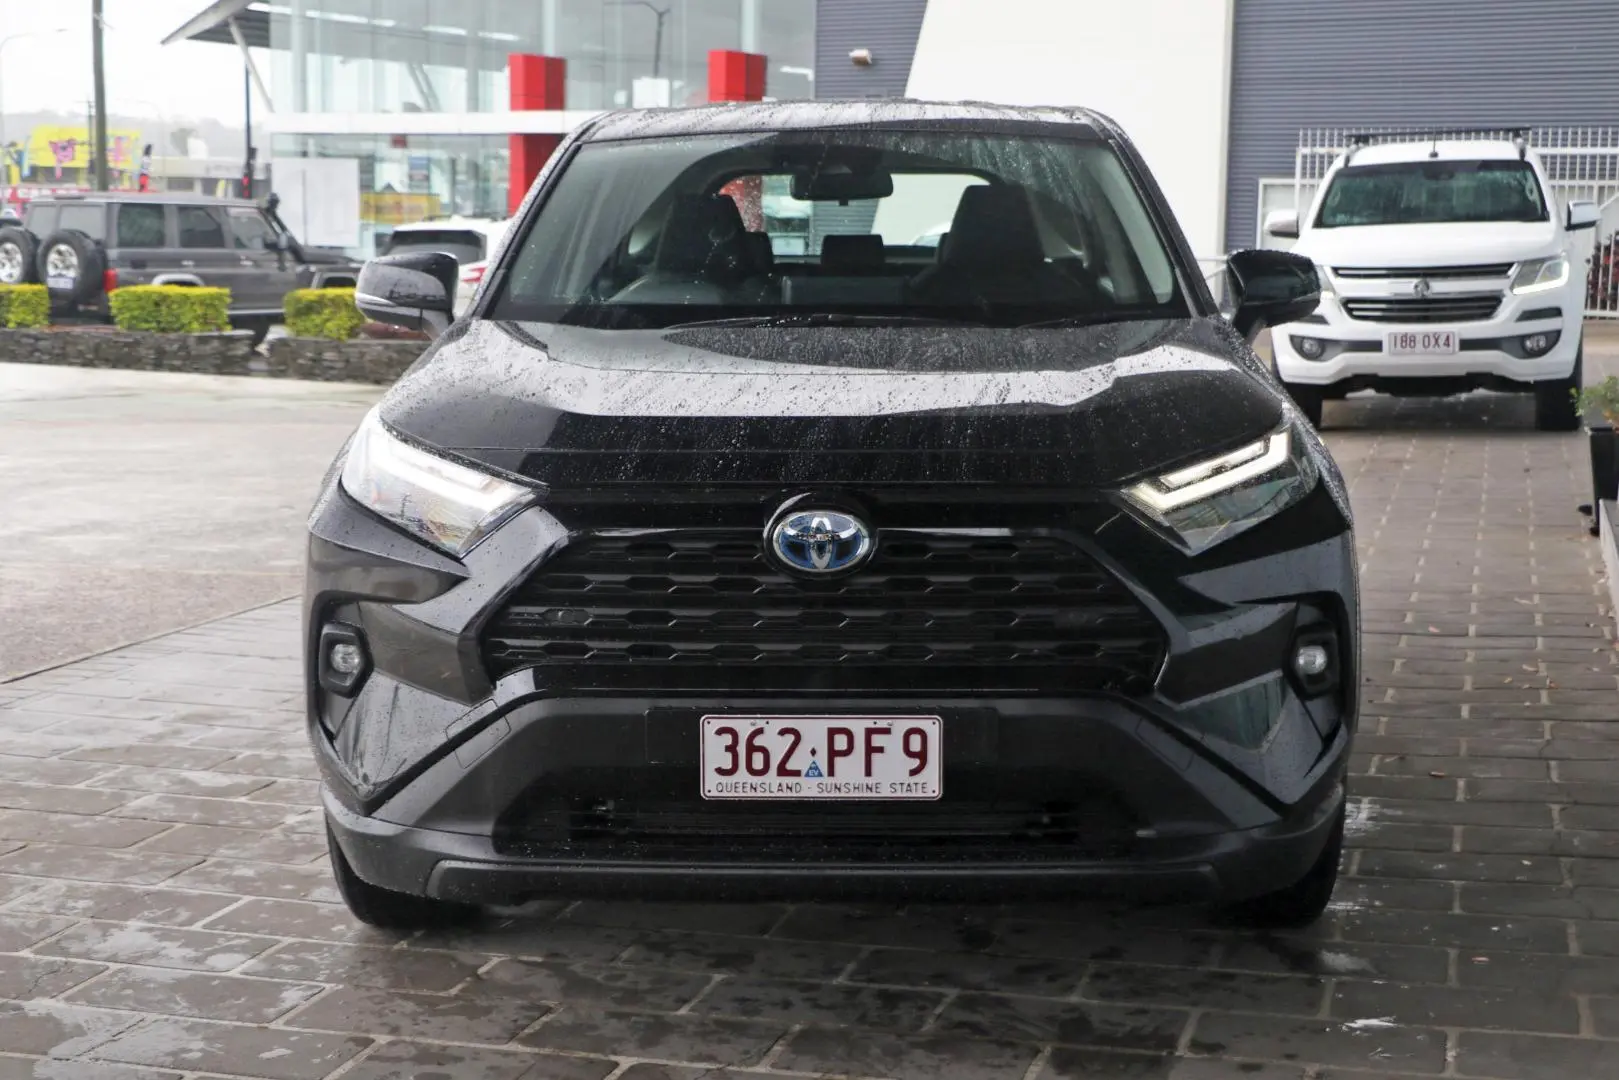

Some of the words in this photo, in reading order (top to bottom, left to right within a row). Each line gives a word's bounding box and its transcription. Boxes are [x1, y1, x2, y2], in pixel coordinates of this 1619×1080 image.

[714, 727, 801, 777] 362
[827, 727, 928, 777] PF9
[715, 782, 802, 793] QUEENSLAND
[816, 782, 881, 793] SUNSHINE
[889, 782, 928, 793] STATE
